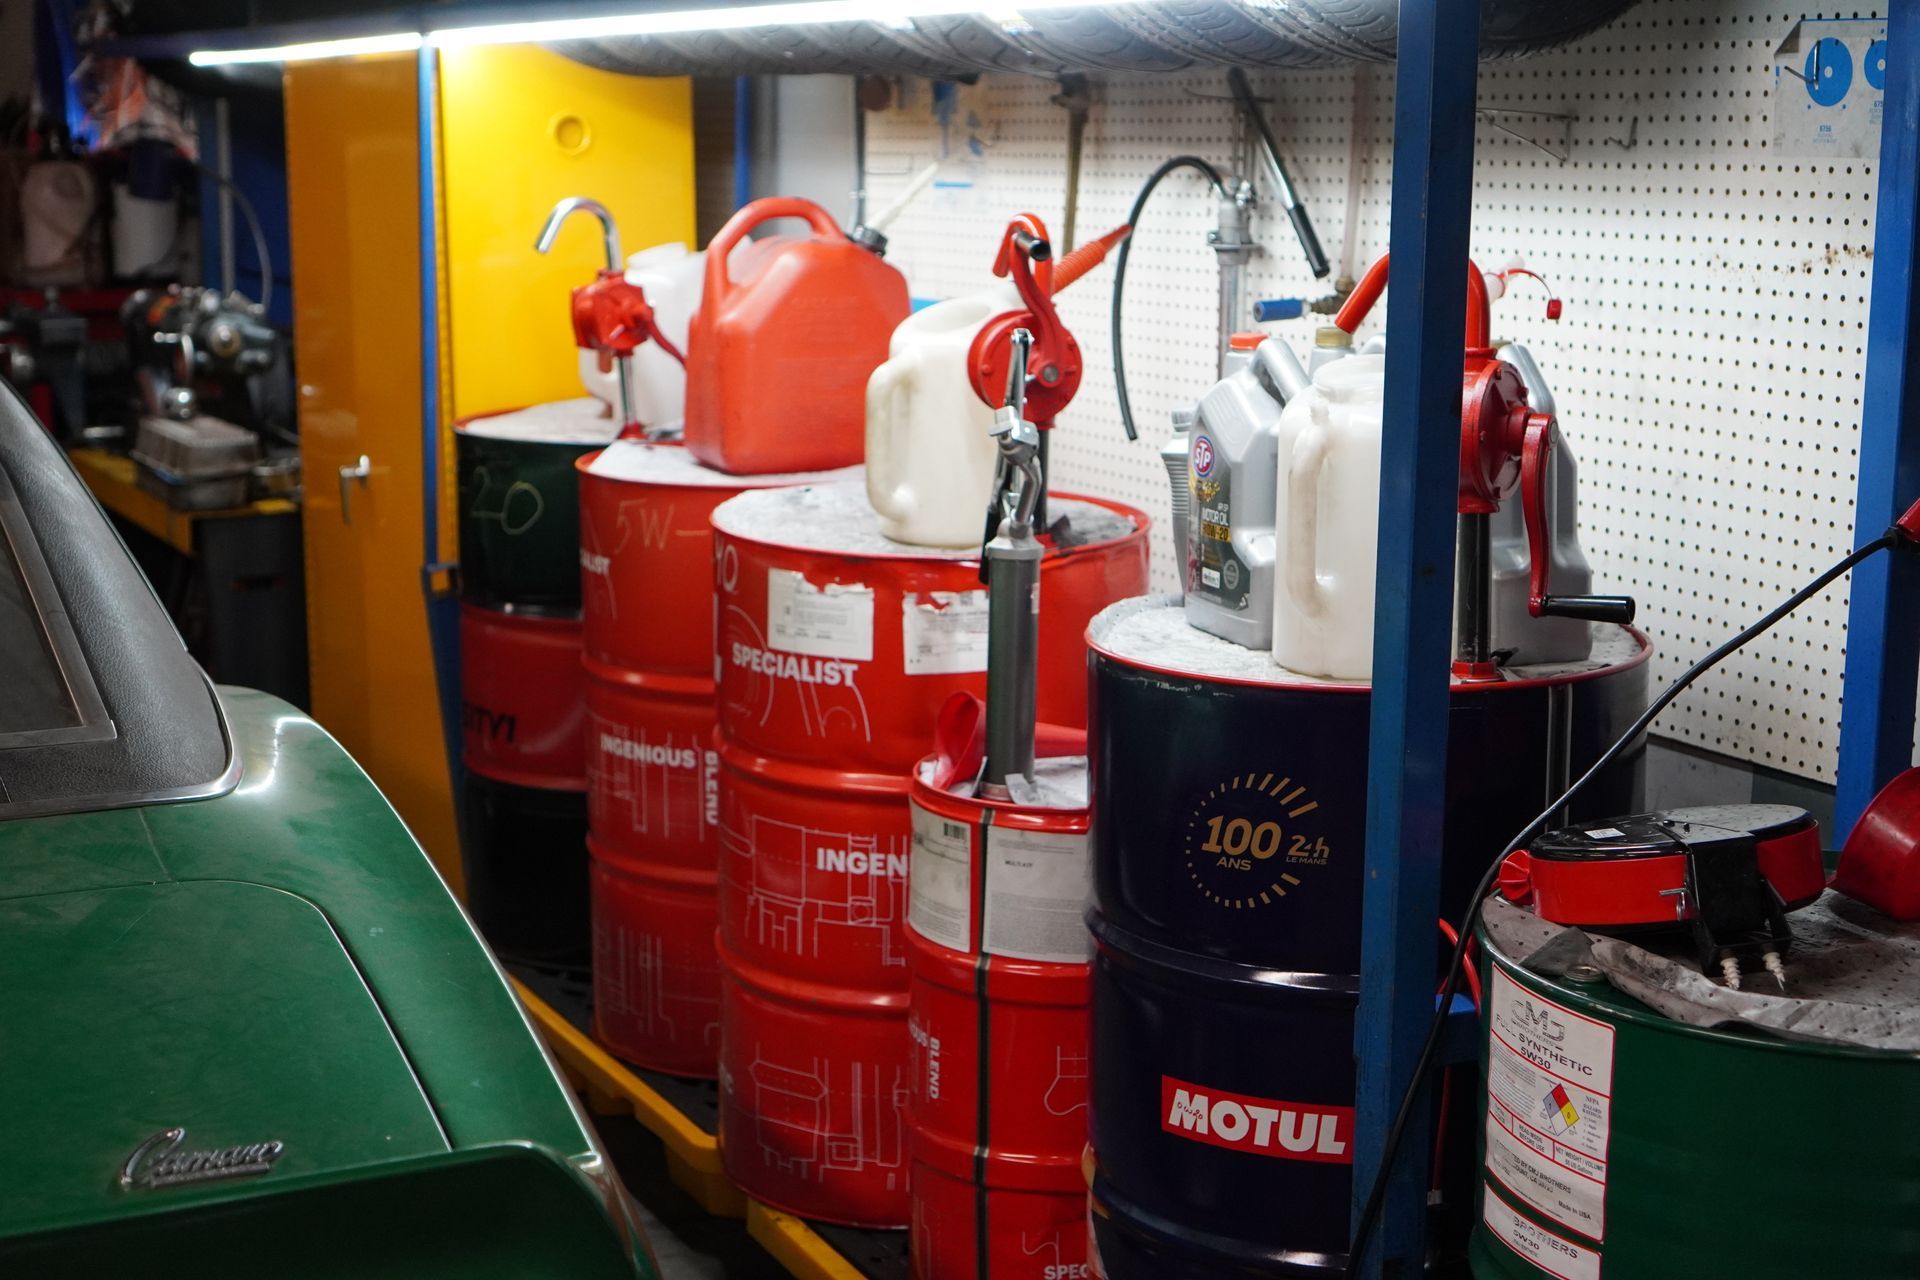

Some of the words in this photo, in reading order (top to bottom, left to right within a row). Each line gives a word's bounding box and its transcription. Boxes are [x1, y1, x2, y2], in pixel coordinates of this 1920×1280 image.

[1194, 442, 1211, 469] STP
[1202, 507, 1219, 523] MOTOR
[1219, 511, 1229, 525] OIL
[732, 642, 859, 687] SPECIALIST
[600, 732, 696, 769] INGENIOUS
[1201, 815, 1282, 859] 100
[1287, 835, 1330, 858] 24h
[816, 848, 908, 877] INGEN
[1216, 856, 1252, 871] ANS
[1298, 857, 1327, 865] MANS
[929, 1037, 940, 1100] BLEND
[1520, 1046, 1551, 1070] 5W30
[1168, 1088, 1346, 1155] MOTUL
[121, 1127, 283, 1187] Camaro
[1565, 1149, 1581, 1162] WEIGHT
[1585, 1159, 1604, 1172] VOLUME
[1528, 1163, 1540, 1177] CMJ
[1540, 1172, 1571, 1193] BROTHERS
[1558, 1200, 1571, 1212] Made
[1578, 1209, 1591, 1220] USA
[1513, 1216, 1578, 1259] BROTHERS
[1513, 1229, 1540, 1250] 5W30
[1044, 1263, 1088, 1280] SPEC
